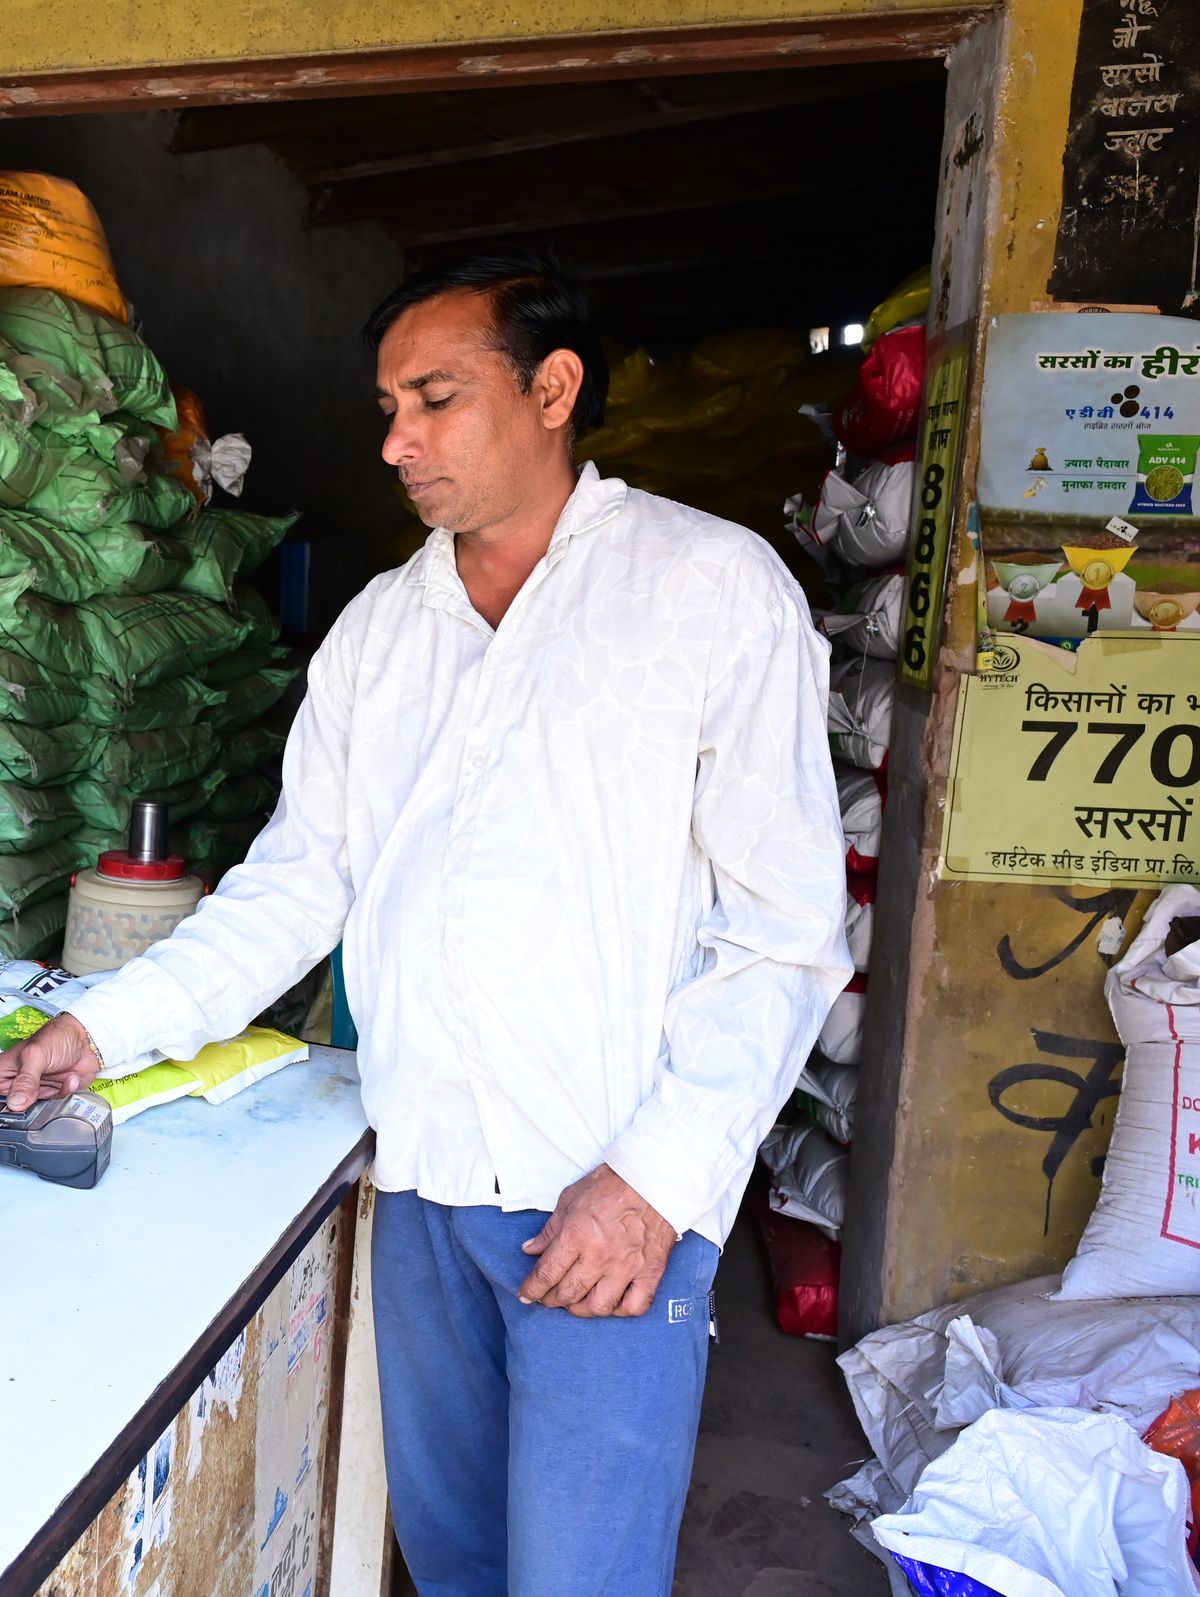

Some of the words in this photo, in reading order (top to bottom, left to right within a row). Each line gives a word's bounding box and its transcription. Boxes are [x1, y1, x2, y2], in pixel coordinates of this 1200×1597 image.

[1100, 53, 1164, 87] सरसों
[1038, 350, 1101, 369] सरसों
[1103, 355, 1132, 369] का
[1141, 346, 1200, 379] हीर
[1065, 409, 1075, 420] ए
[1079, 405, 1094, 419] डी
[1097, 405, 1114, 419] वी
[1140, 406, 1174, 419] 414
[1136, 422, 1151, 430] बीज
[1096, 456, 1130, 469] पैदावार
[1149, 456, 1169, 465] ADV
[1170, 456, 1186, 465] 414
[1062, 480, 1093, 492] मुनाफा
[1097, 481, 1126, 491] दमदार
[979, 674, 1018, 682] HYTECH
[1025, 683, 1128, 714] किसानों
[1137, 693, 1176, 715] का
[1075, 795, 1194, 843] सरसों
[991, 846, 1046, 868] हाईटेक
[1052, 849, 1084, 870] सीड
[1091, 850, 1139, 873] इंडिया
